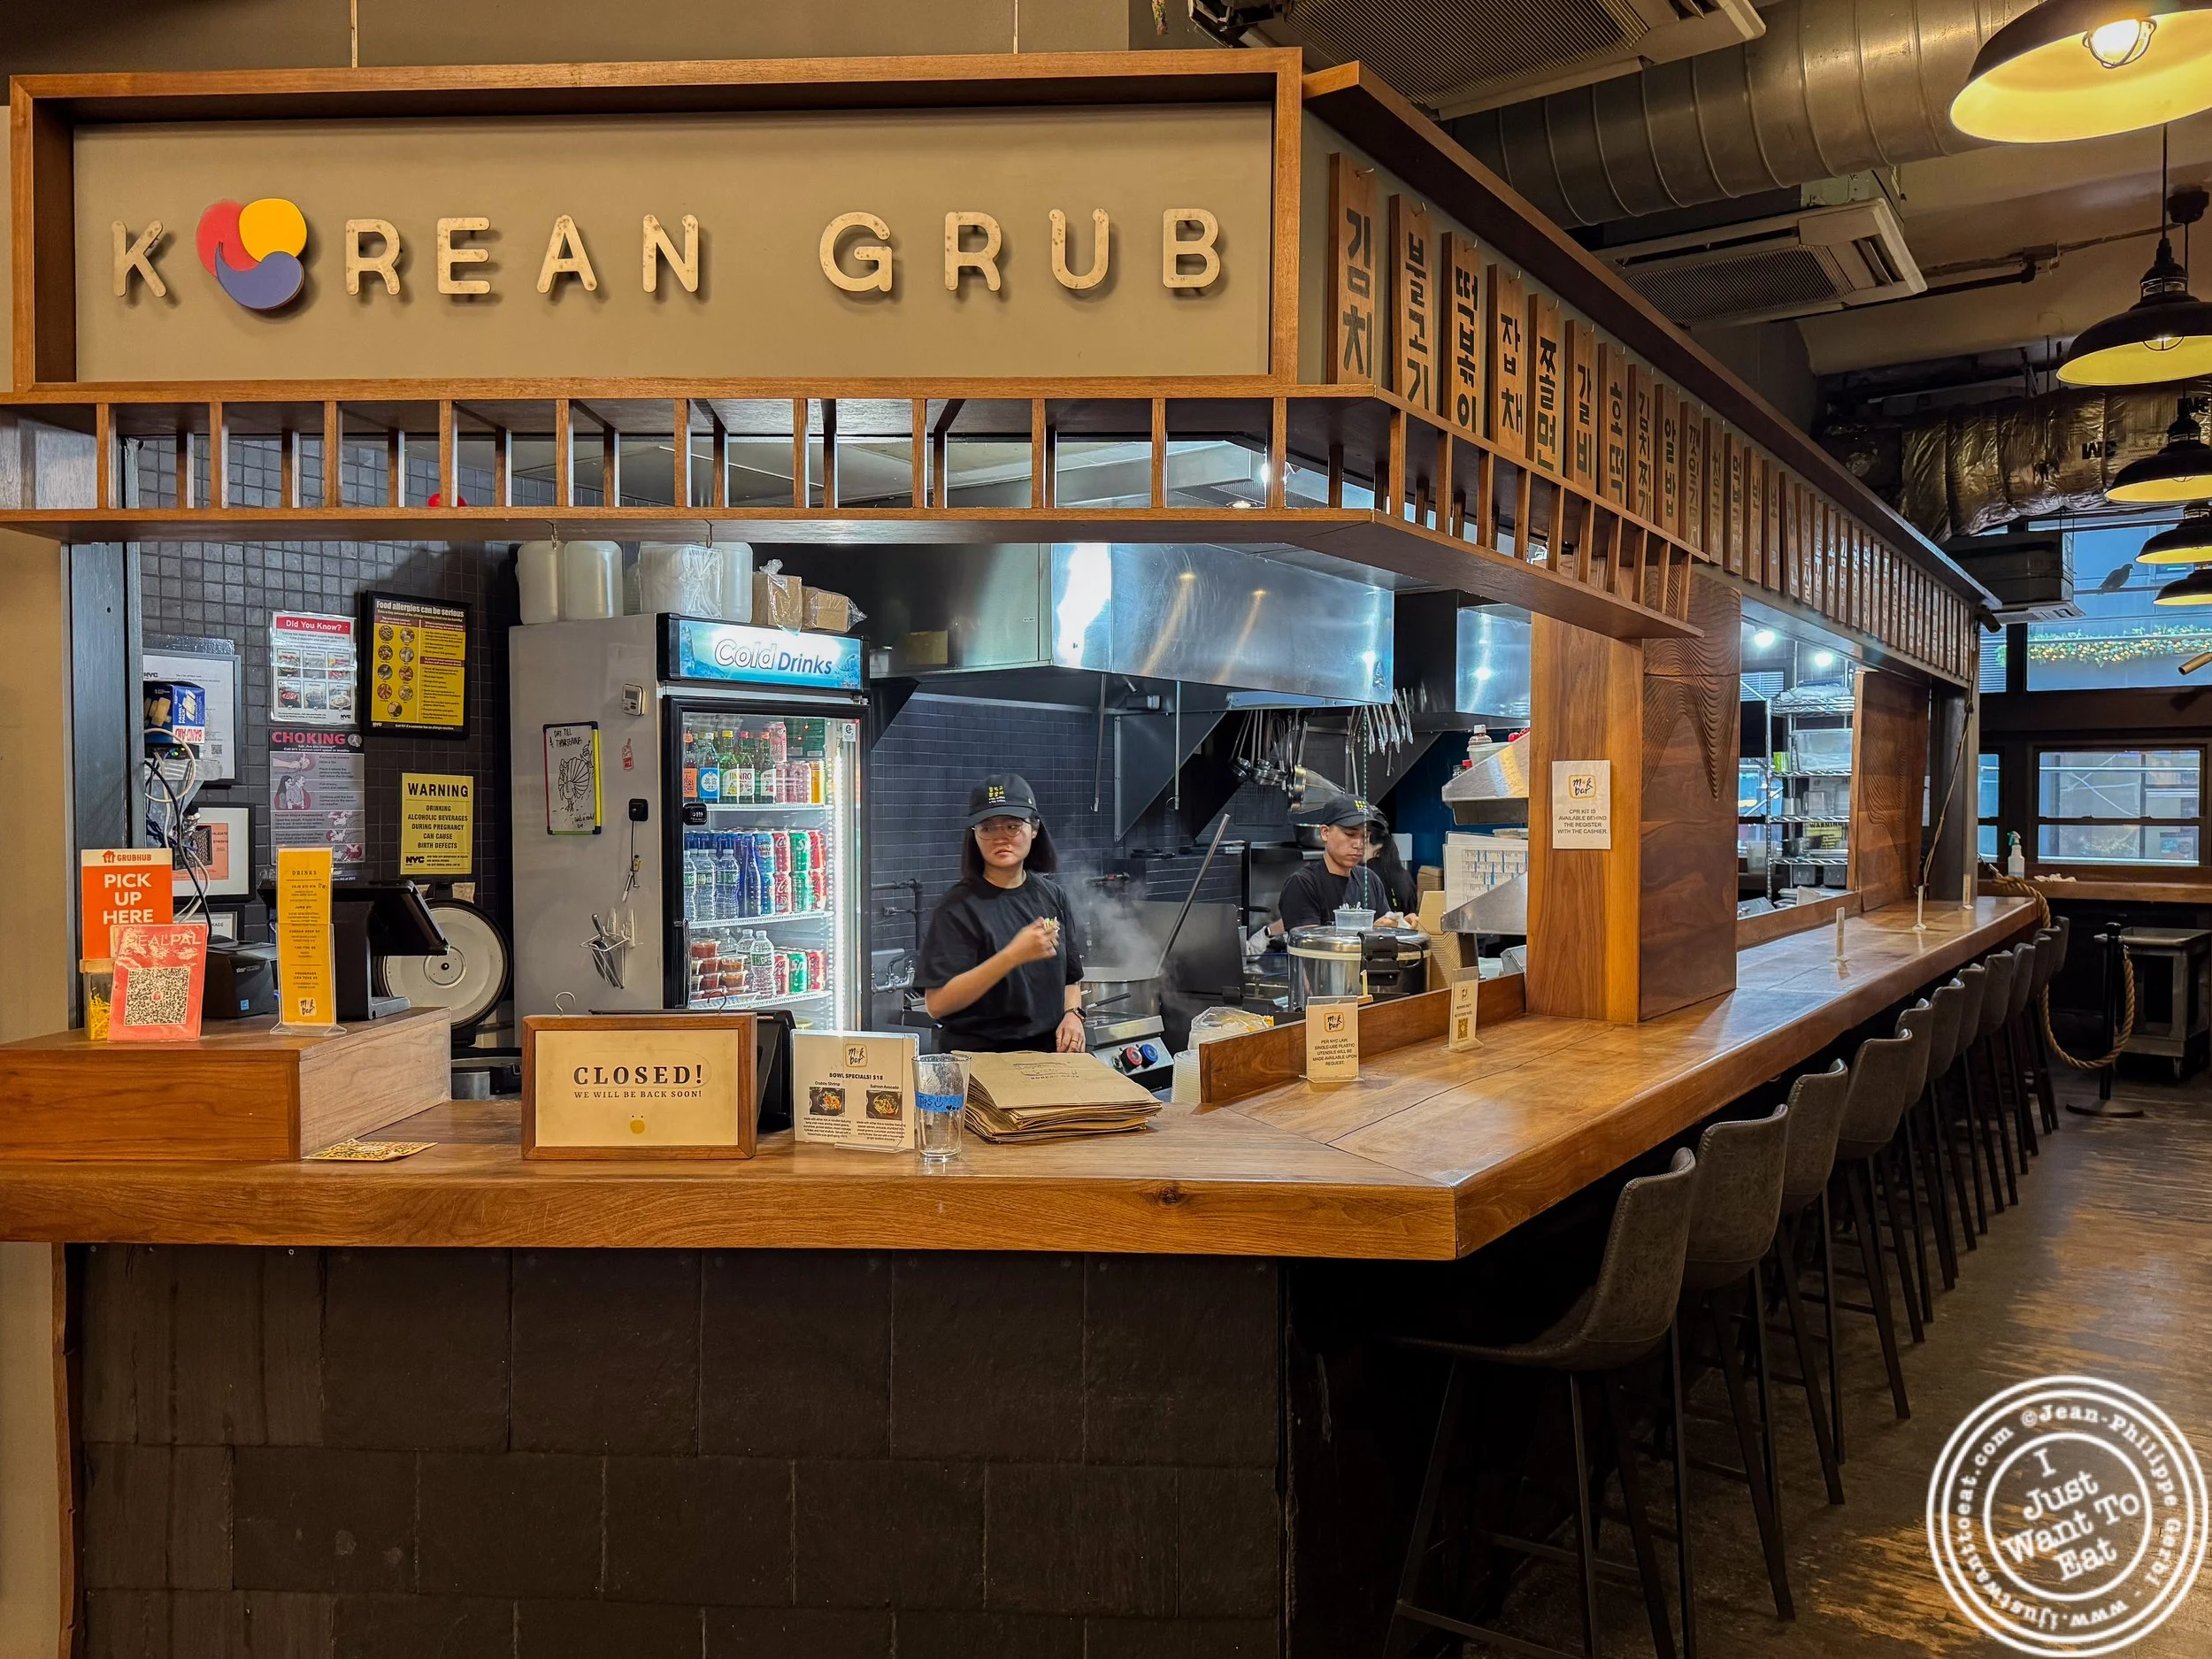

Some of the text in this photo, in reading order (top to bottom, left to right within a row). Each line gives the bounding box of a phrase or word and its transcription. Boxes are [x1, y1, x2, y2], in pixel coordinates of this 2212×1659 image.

[819, 208, 1221, 292] GRUB
[1342, 207, 1372, 379] 김치
[1405, 232, 1430, 411] 불고기
[1455, 265, 1479, 434] 떡볶이
[1501, 313, 1524, 436] 잡채
[1537, 336, 1557, 472] 쫄면
[1576, 363, 1593, 480] 갈비
[1609, 381, 1625, 505] 호떡
[1664, 417, 1677, 518] 알밥
[317, 622, 342, 631] Know?
[376, 601, 392, 610] Food
[392, 603, 420, 613] allergies
[442, 608, 465, 618] serious
[714, 639, 833, 675] Cold Drinks
[271, 732, 346, 745] CHOKING
[408, 782, 469, 798] WARNING
[104, 872, 152, 888] PICK
[114, 891, 142, 906] UP
[103, 909, 154, 925] HERE
[126, 933, 202, 947] EALPAL
[573, 1064, 702, 1085] CLOSED!
